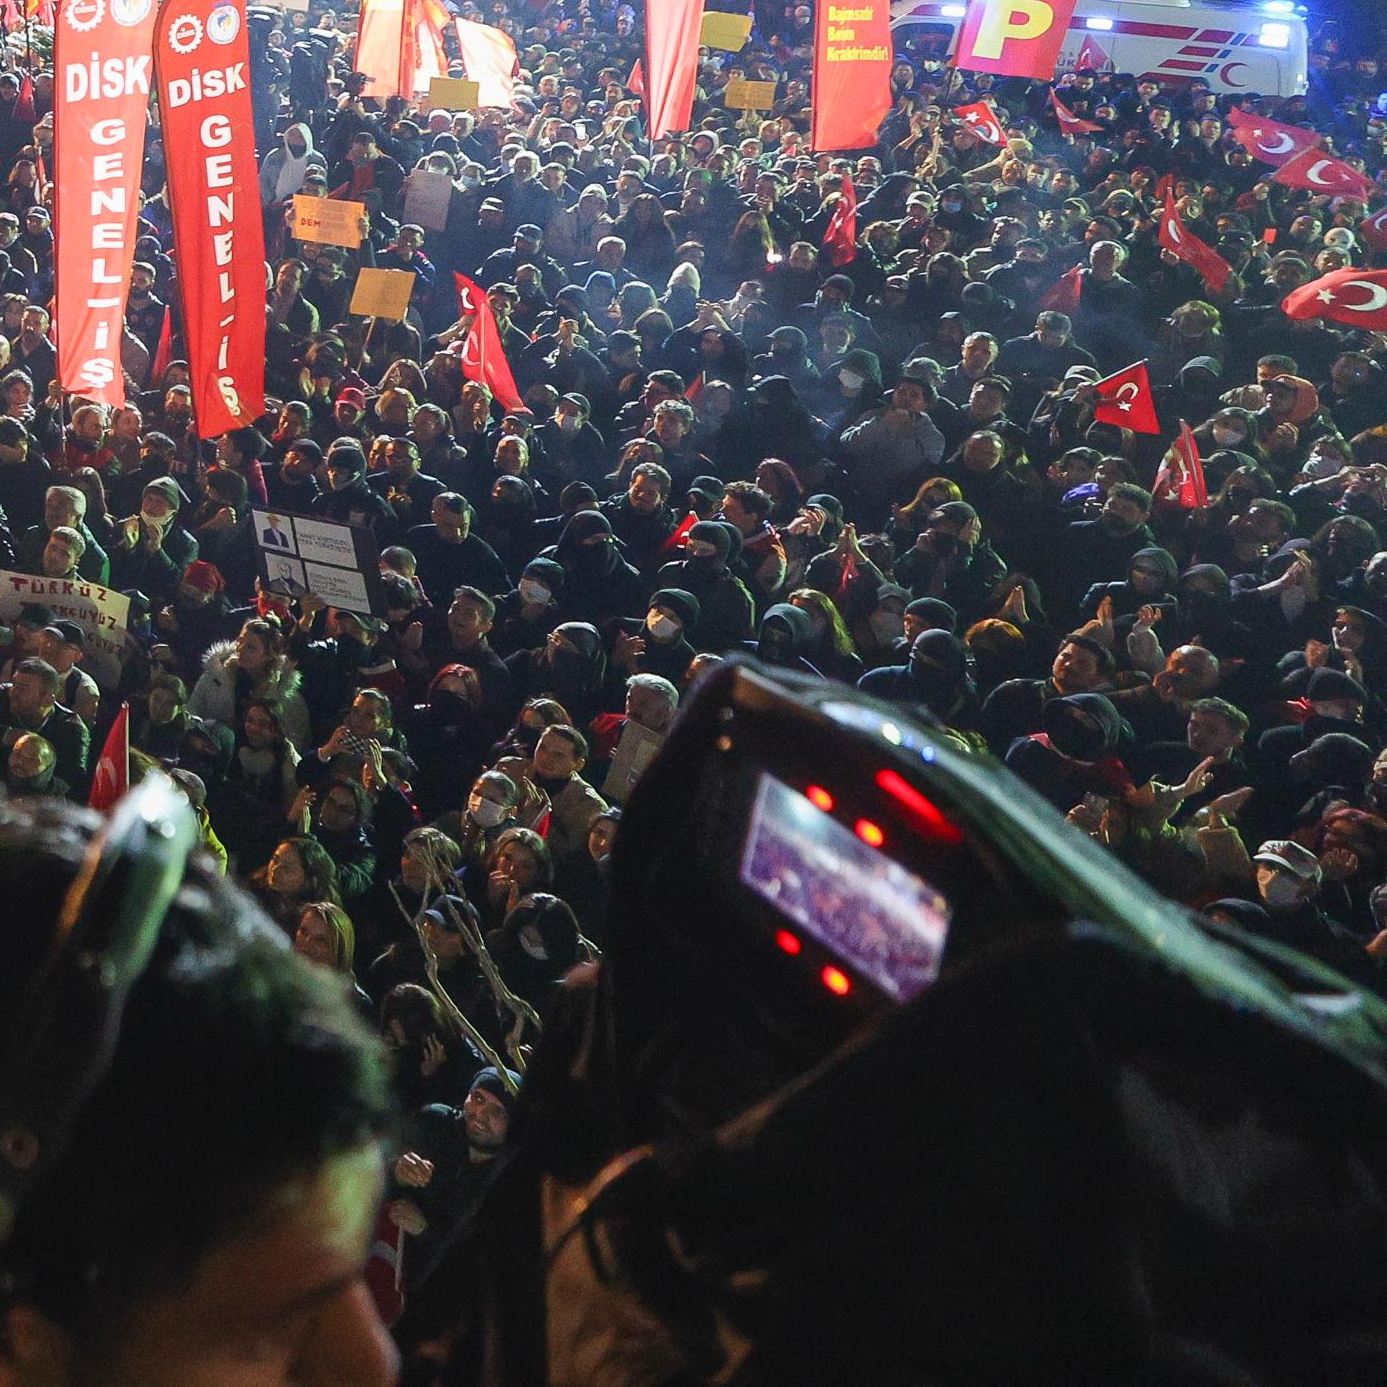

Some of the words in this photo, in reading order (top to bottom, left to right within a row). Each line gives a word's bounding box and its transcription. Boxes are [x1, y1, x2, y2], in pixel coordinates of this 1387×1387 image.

[66, 51, 151, 103] DİSK
[167, 62, 247, 110] DİSK
[80, 118, 126, 390] GENEL-İŞ
[9, 576, 107, 602] TÜRKÜZ
